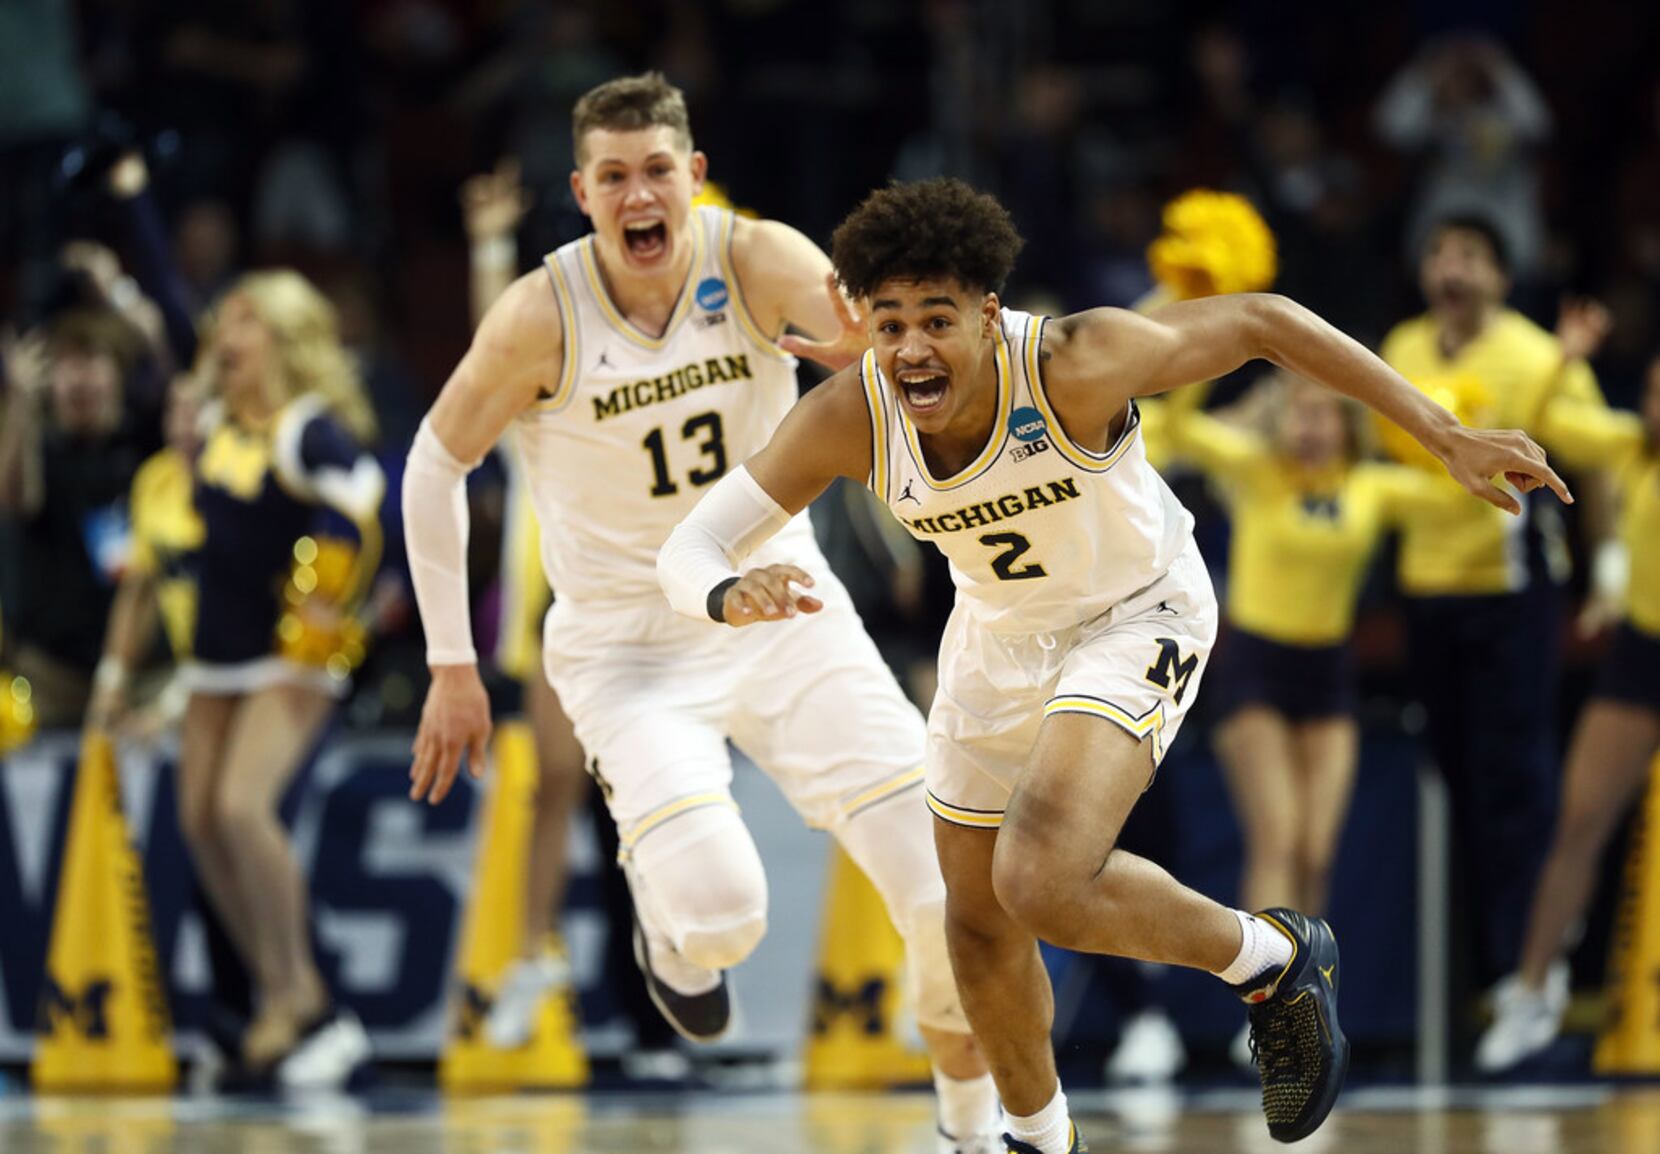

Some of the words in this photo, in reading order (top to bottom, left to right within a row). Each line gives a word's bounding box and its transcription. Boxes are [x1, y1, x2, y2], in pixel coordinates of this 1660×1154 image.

[592, 353, 753, 422] MICHIGAN
[642, 409, 728, 497] 13
[978, 532, 1048, 581] 2
[1145, 638, 1199, 706] M
